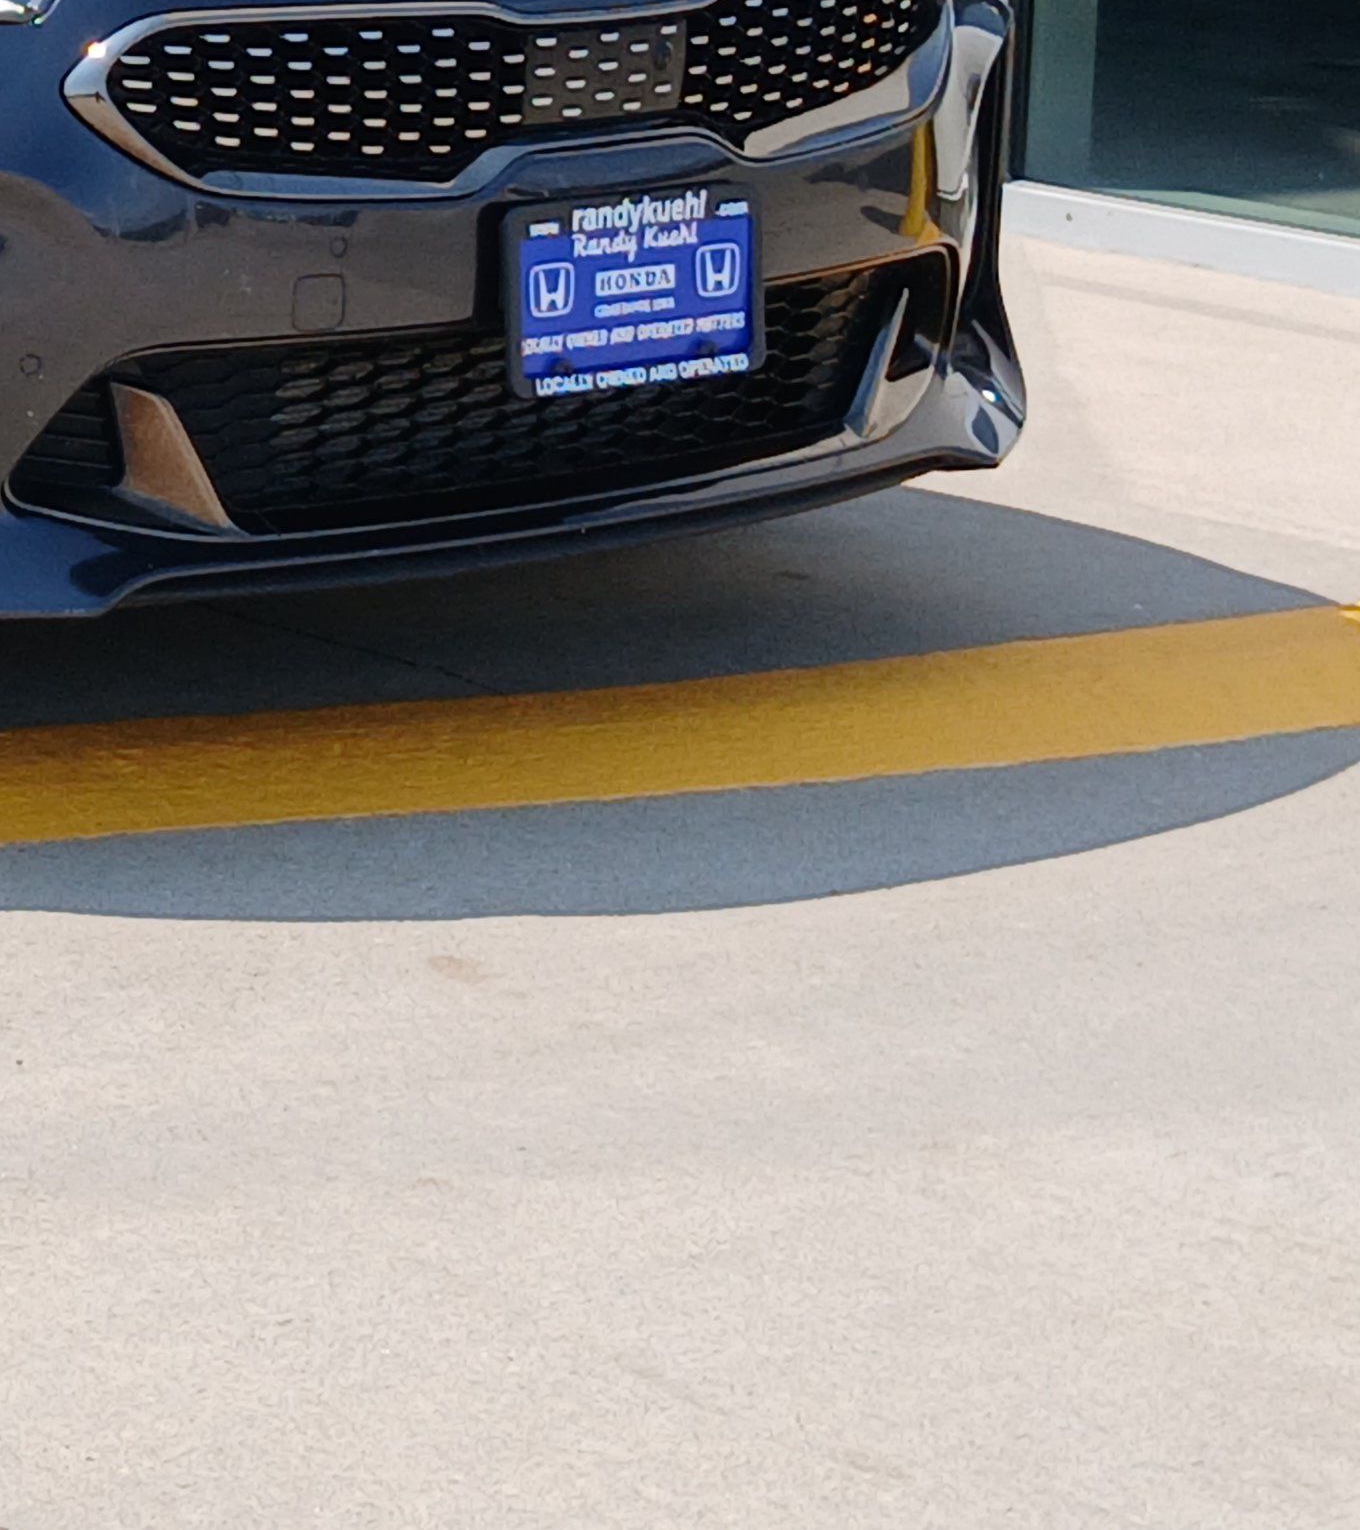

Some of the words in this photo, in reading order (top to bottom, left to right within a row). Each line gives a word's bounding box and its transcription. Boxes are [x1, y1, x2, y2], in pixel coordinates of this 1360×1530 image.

[572, 189, 708, 232] randykuehl
[572, 234, 638, 262] Randy
[644, 222, 698, 249] Kuehl
[600, 268, 671, 291] HONDA
